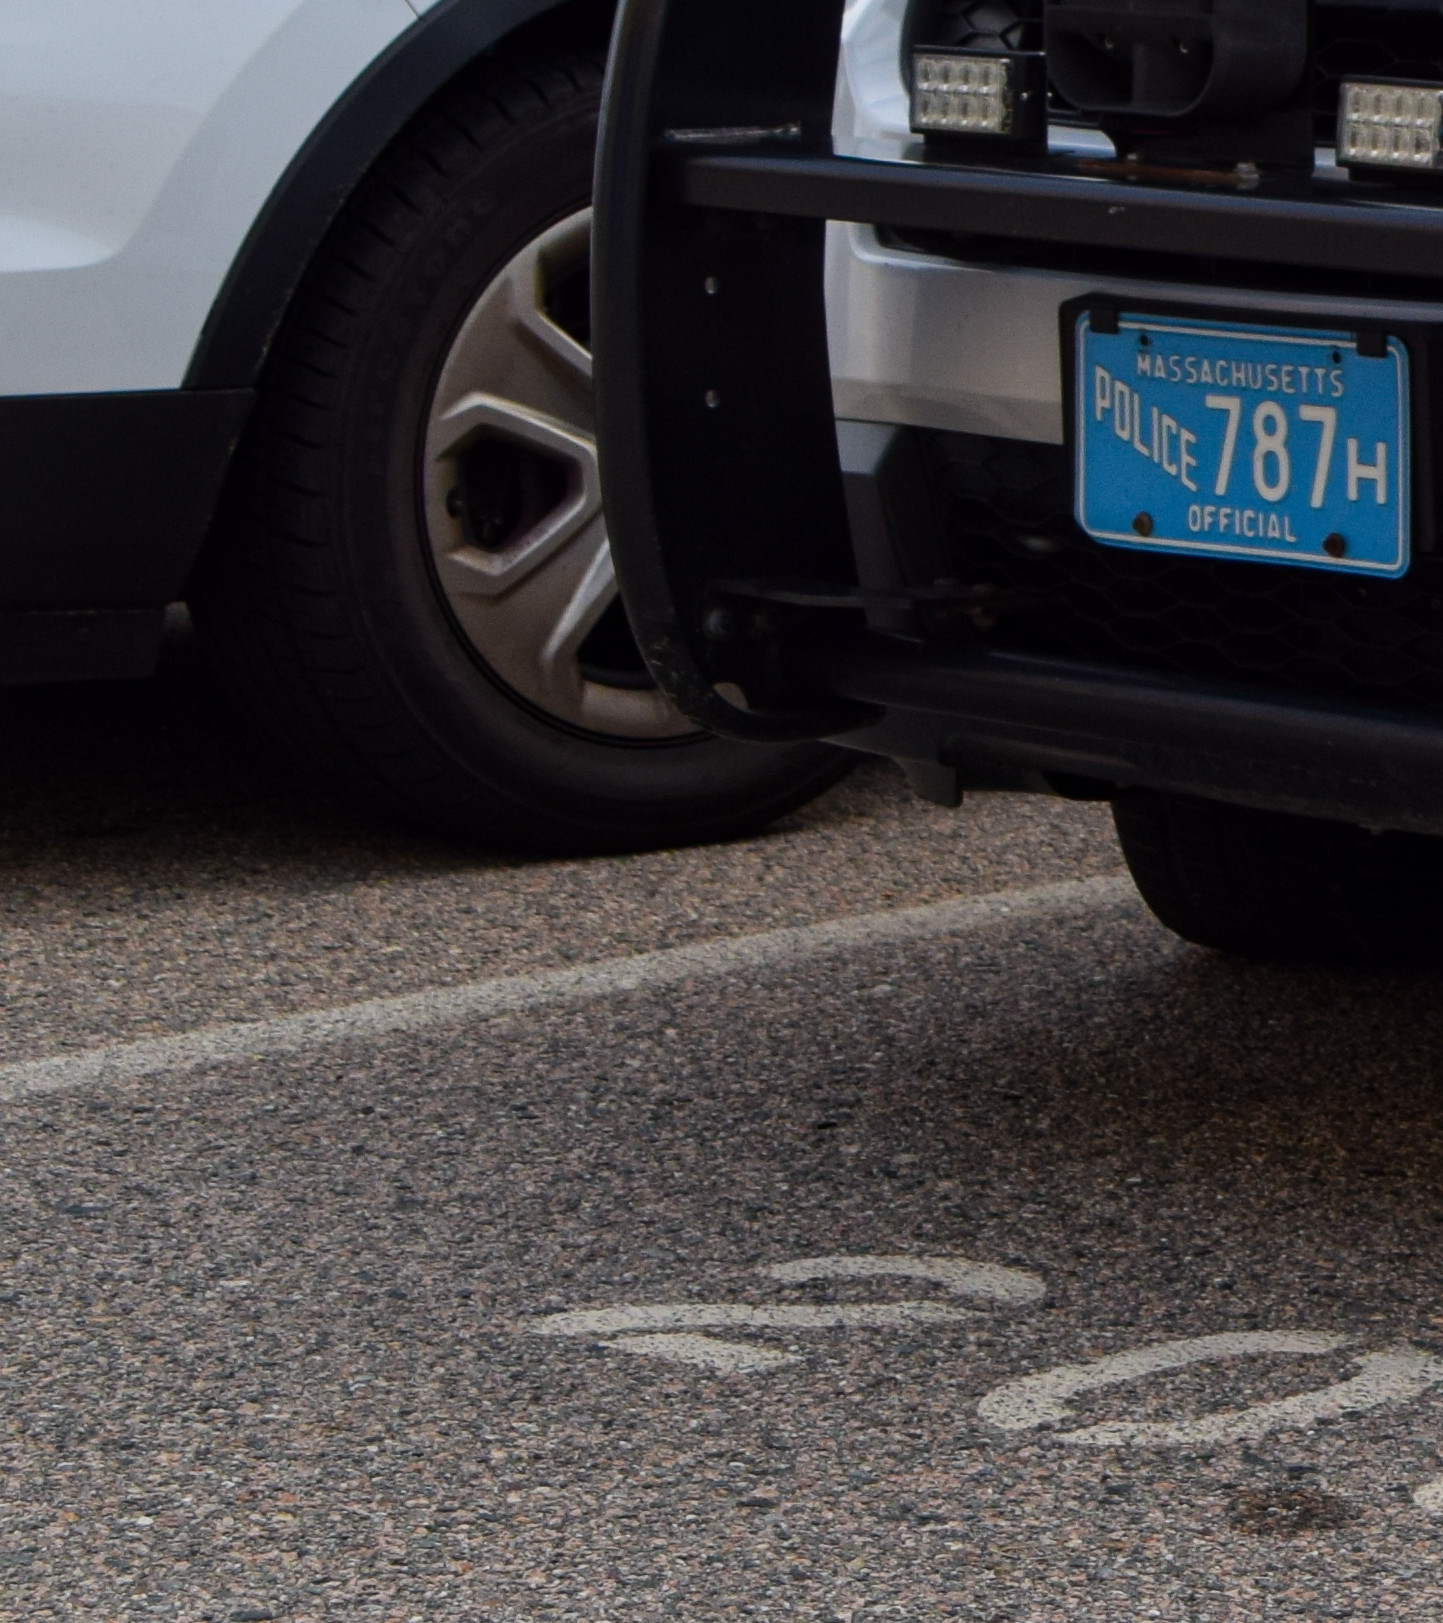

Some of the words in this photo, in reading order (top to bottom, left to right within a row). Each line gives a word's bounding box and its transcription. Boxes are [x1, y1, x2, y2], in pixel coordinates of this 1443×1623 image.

[1135, 353, 1345, 399] MASSACHUSETTS
[1093, 364, 1198, 493] POLICE
[1188, 503, 1297, 544] OFFICIAL
